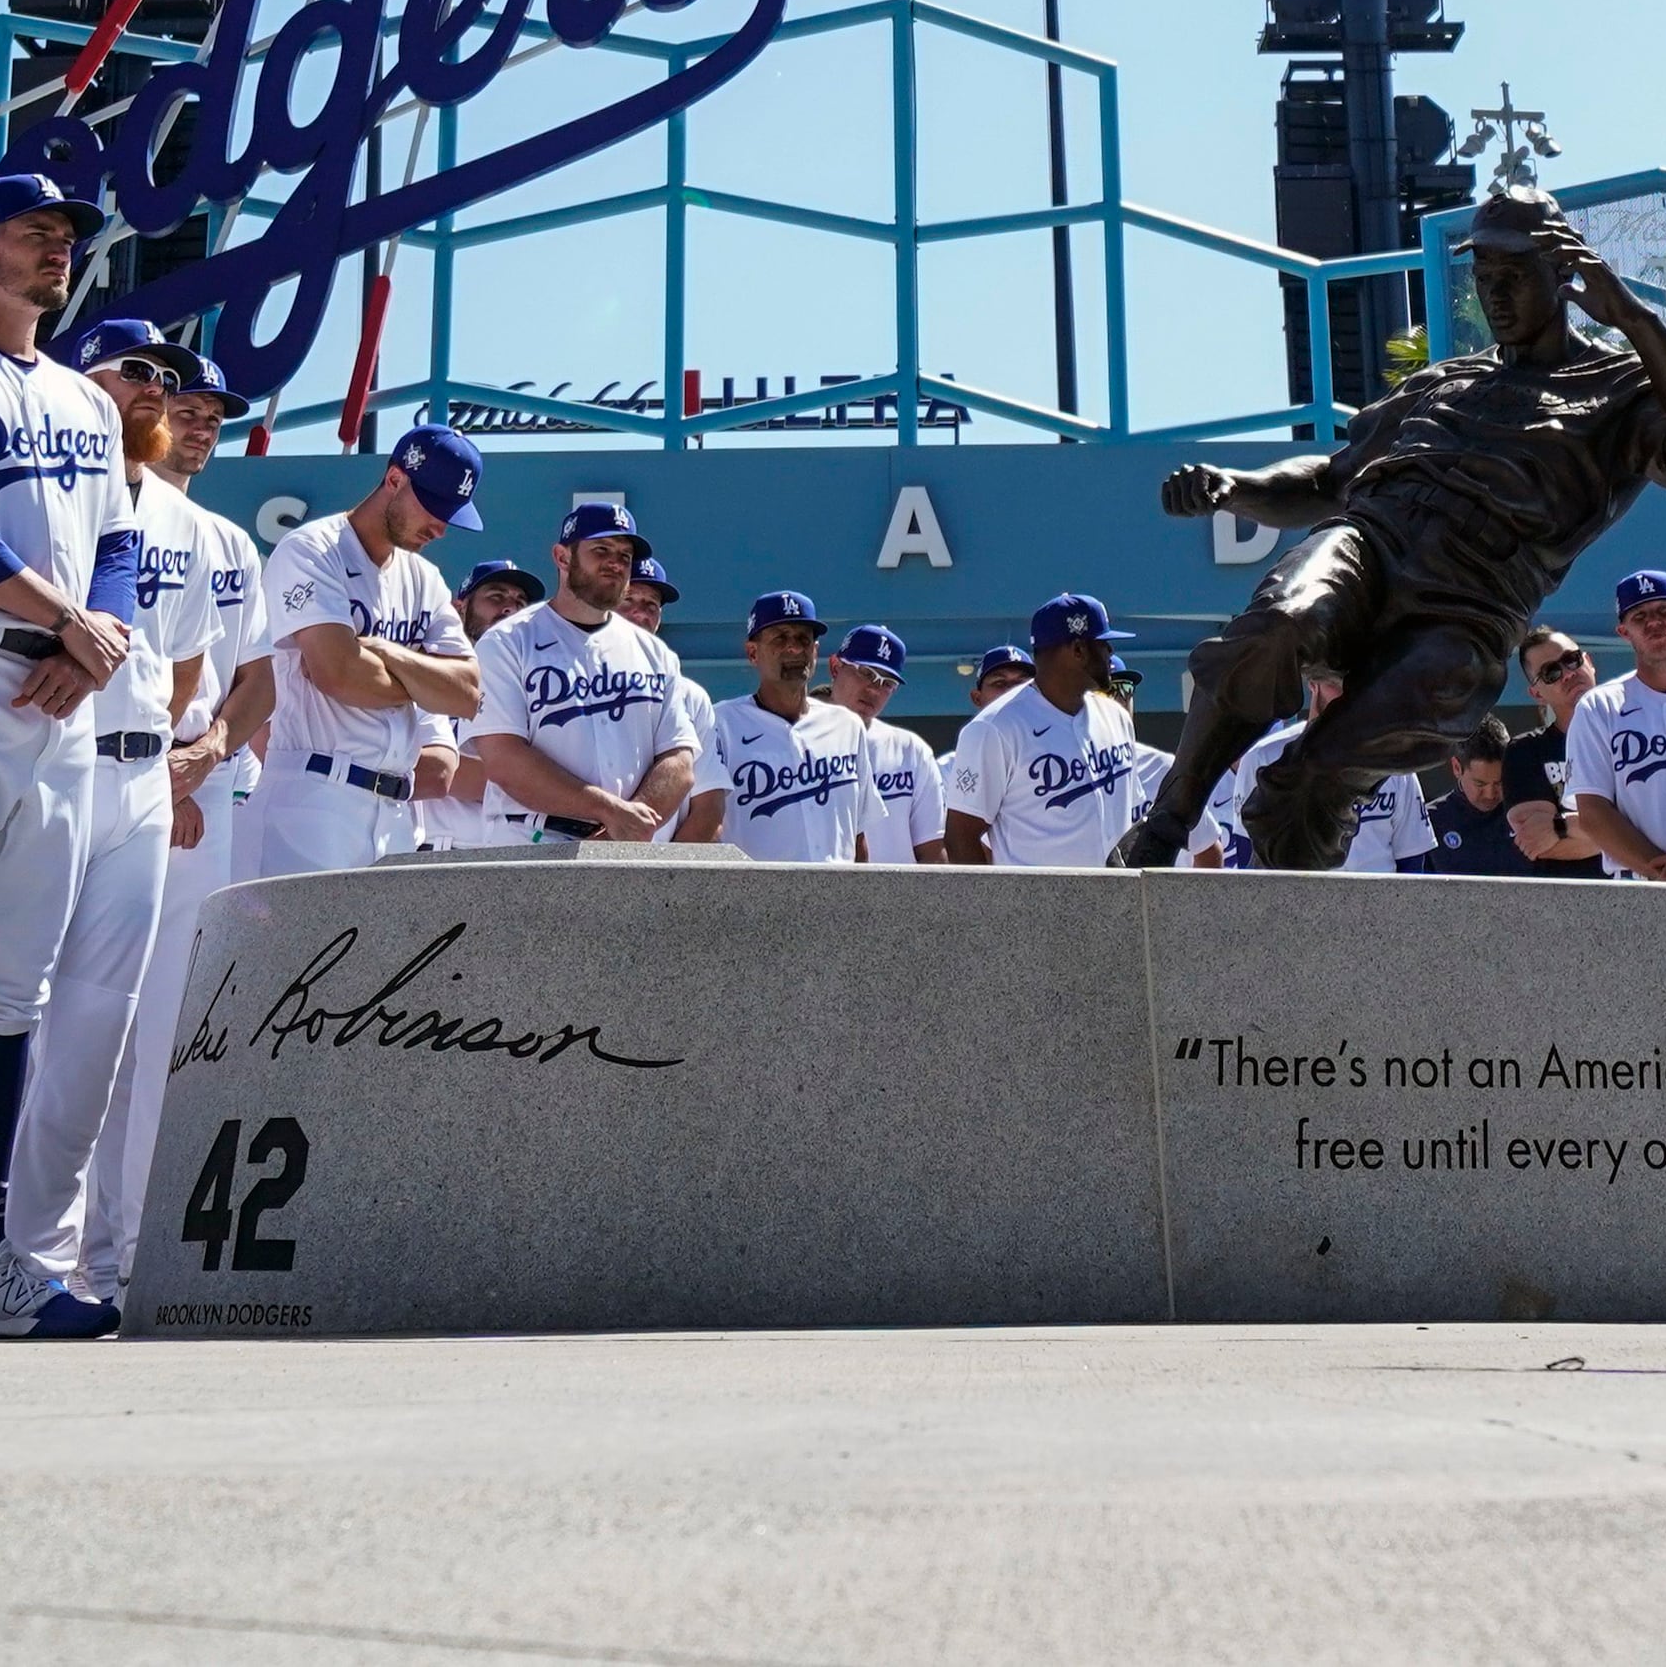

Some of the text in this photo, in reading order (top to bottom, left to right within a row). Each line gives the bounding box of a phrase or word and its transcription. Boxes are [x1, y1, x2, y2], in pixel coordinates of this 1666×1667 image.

[457, 469, 474, 496] LA
[782, 594, 800, 615] LA
[1636, 575, 1656, 594] LA
[878, 636, 892, 661] LA
[733, 749, 859, 821] Dodger
[1028, 740, 1134, 811] Dodger
[249, 922, 685, 1069] Robinson
[1384, 1048, 1454, 1089] not
[1468, 1057, 1522, 1089] an
[1295, 1116, 1385, 1170] free
[1403, 1118, 1490, 1170] until
[1506, 1137, 1628, 1185] every
[181, 1117, 311, 1272] 42
[155, 1303, 313, 1328] BROOKLYN DODGERS
